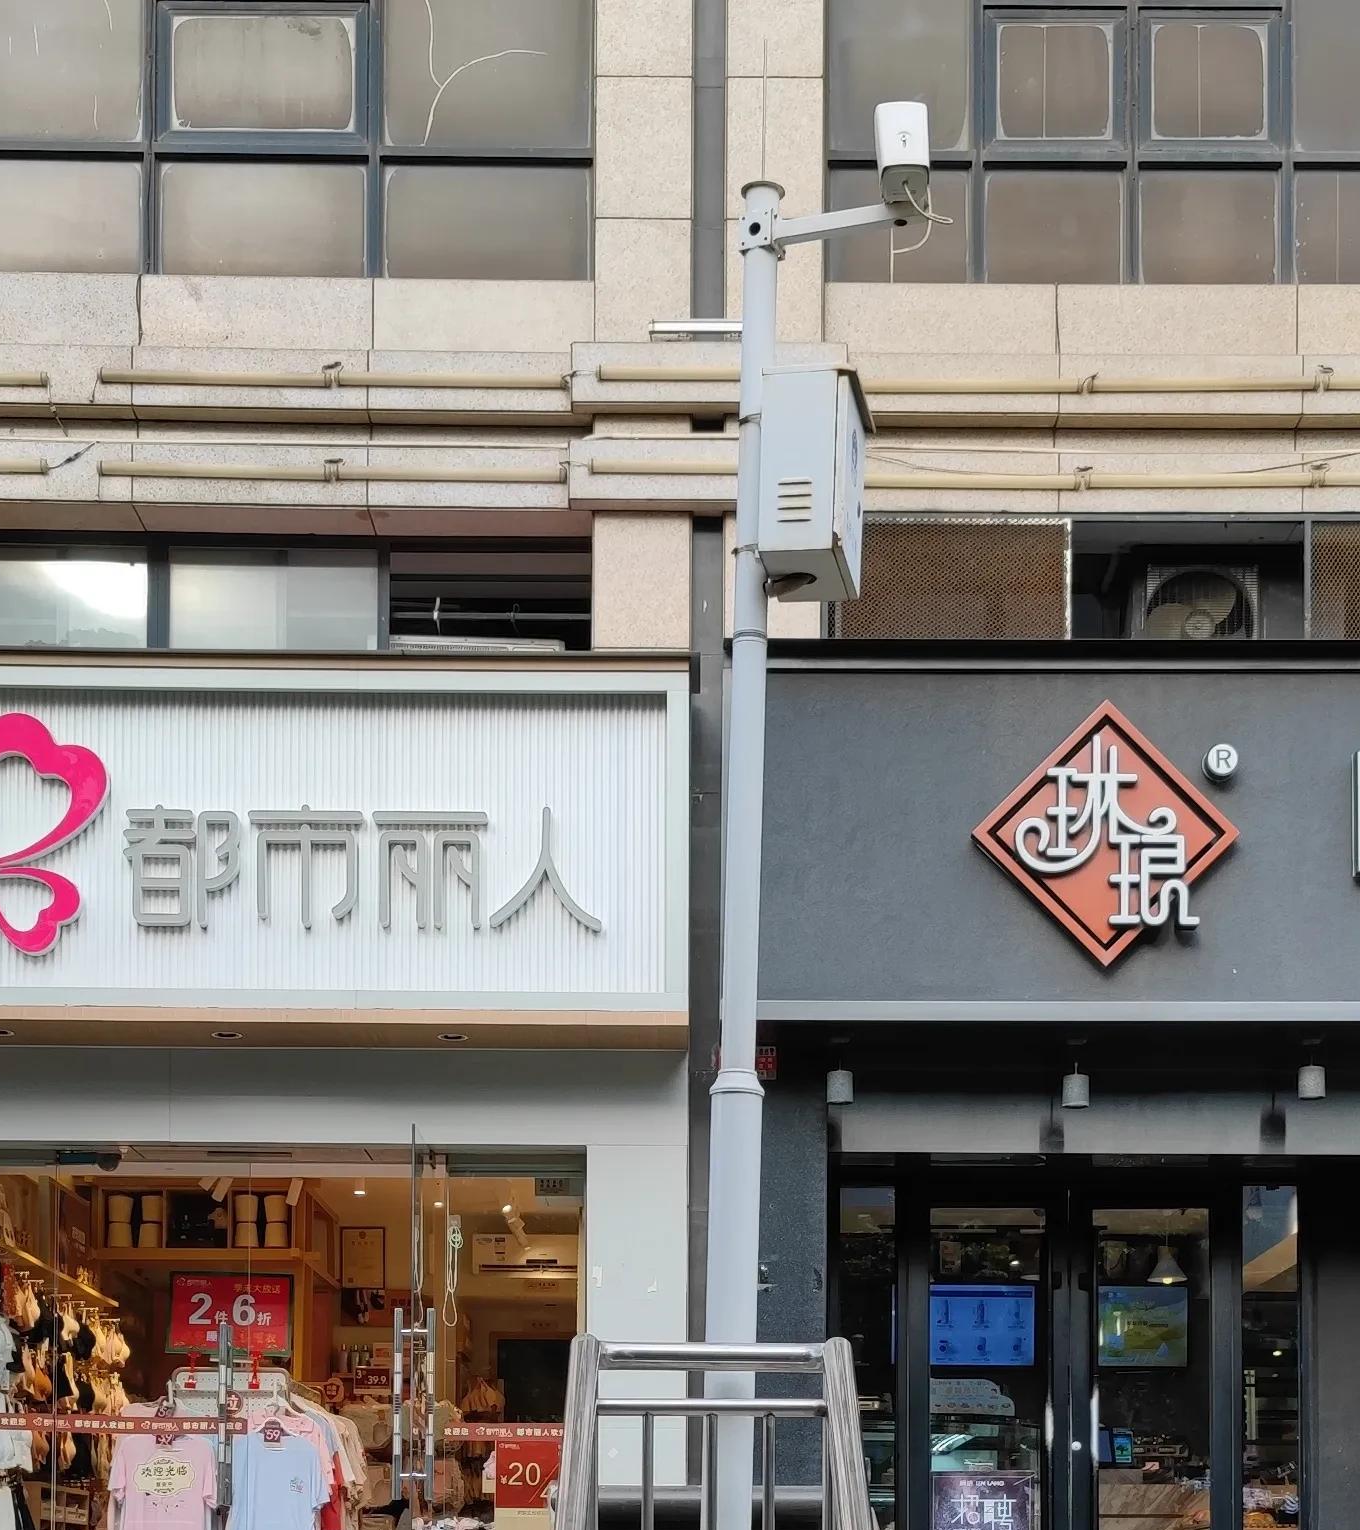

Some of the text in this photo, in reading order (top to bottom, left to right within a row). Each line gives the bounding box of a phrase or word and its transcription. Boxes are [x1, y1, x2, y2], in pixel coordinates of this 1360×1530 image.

[123, 804, 602, 933] 都市丽人
[188, 1293, 272, 1326] 2件6折
[182, 1421, 243, 1430] 都市丽人迎您
[140, 1466, 188, 1478] 欢迎光临
